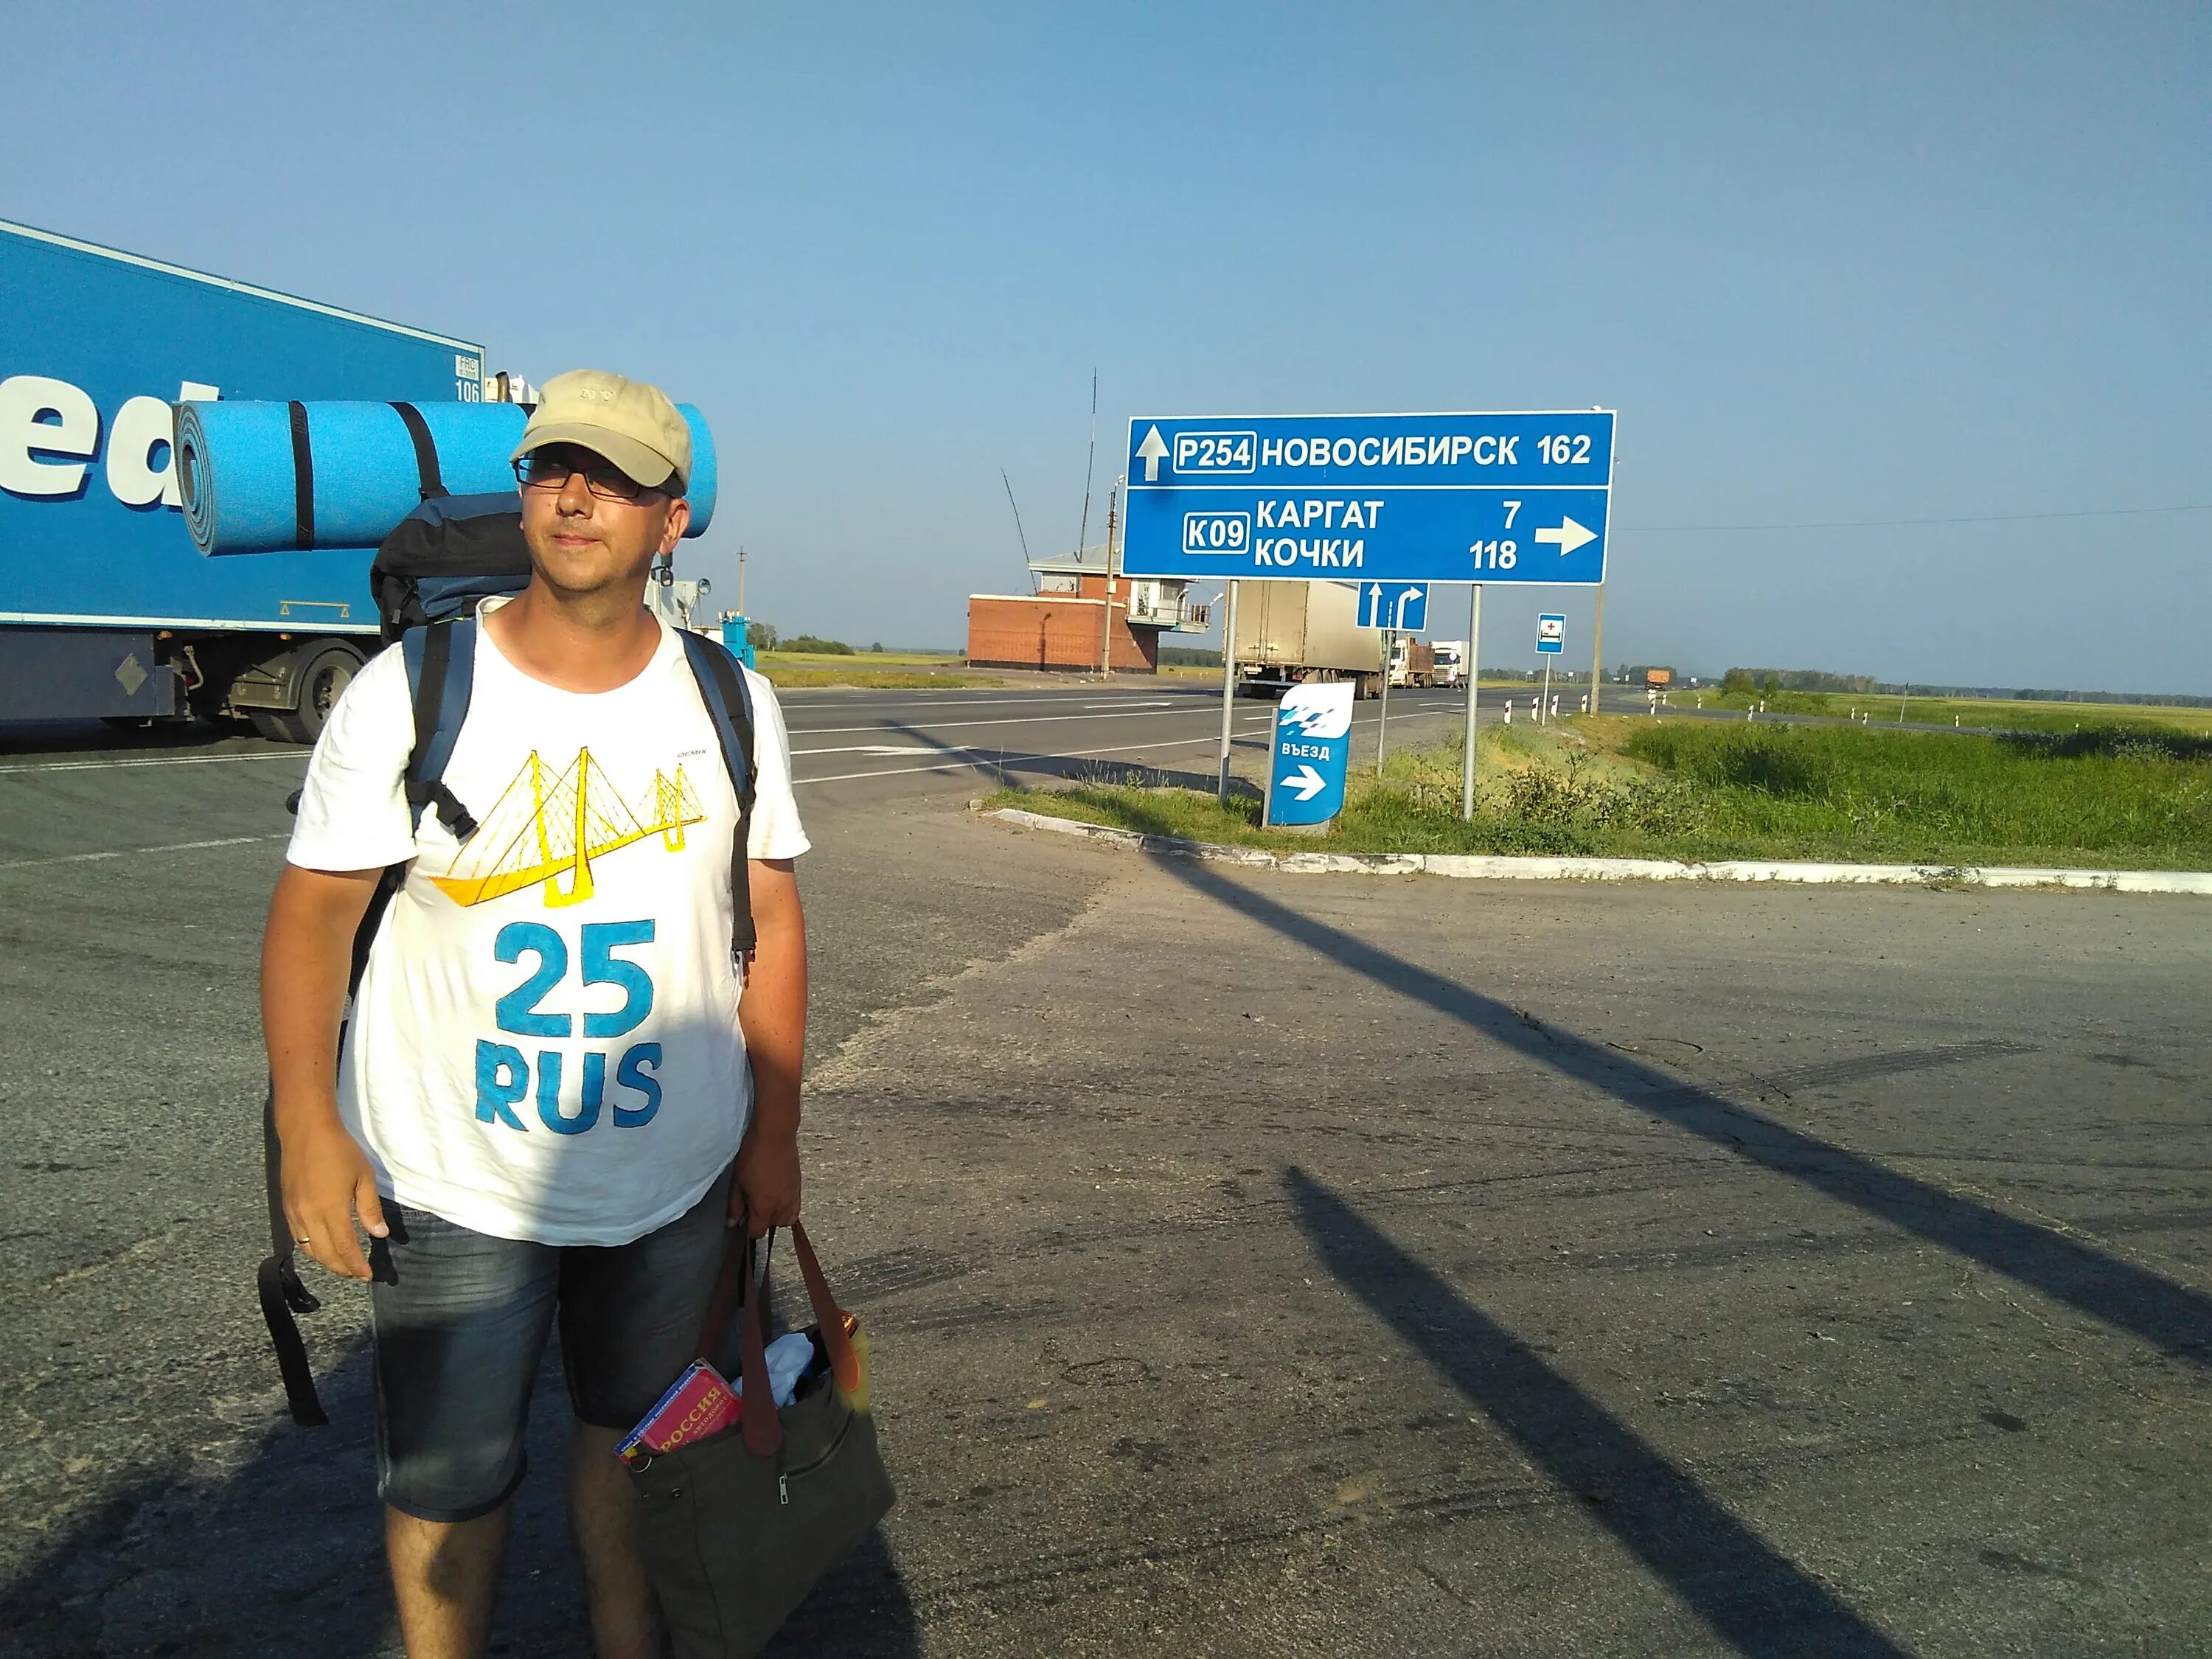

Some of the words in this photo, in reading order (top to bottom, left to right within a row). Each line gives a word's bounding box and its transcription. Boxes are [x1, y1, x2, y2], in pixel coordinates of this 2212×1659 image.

[460, 356, 475, 370] FRC
[456, 379, 479, 403] 106
[1179, 439, 1251, 466] Р254
[1262, 436, 1520, 467] НОВОСИБИРСК
[1537, 434, 1591, 465] 162
[1256, 500, 1385, 529] КАРГАТ
[1503, 501, 1522, 529] 7
[1189, 519, 1245, 547] К09
[1255, 538, 1364, 567] КОЧКИ
[1470, 540, 1517, 569] 118
[677, 748, 707, 758] DEMIX
[1281, 743, 1330, 762] ВЪЕЗД
[495, 919, 655, 1038] 25
[476, 1039, 663, 1135] RUS
[660, 1386, 721, 1453] РОССИЯ
